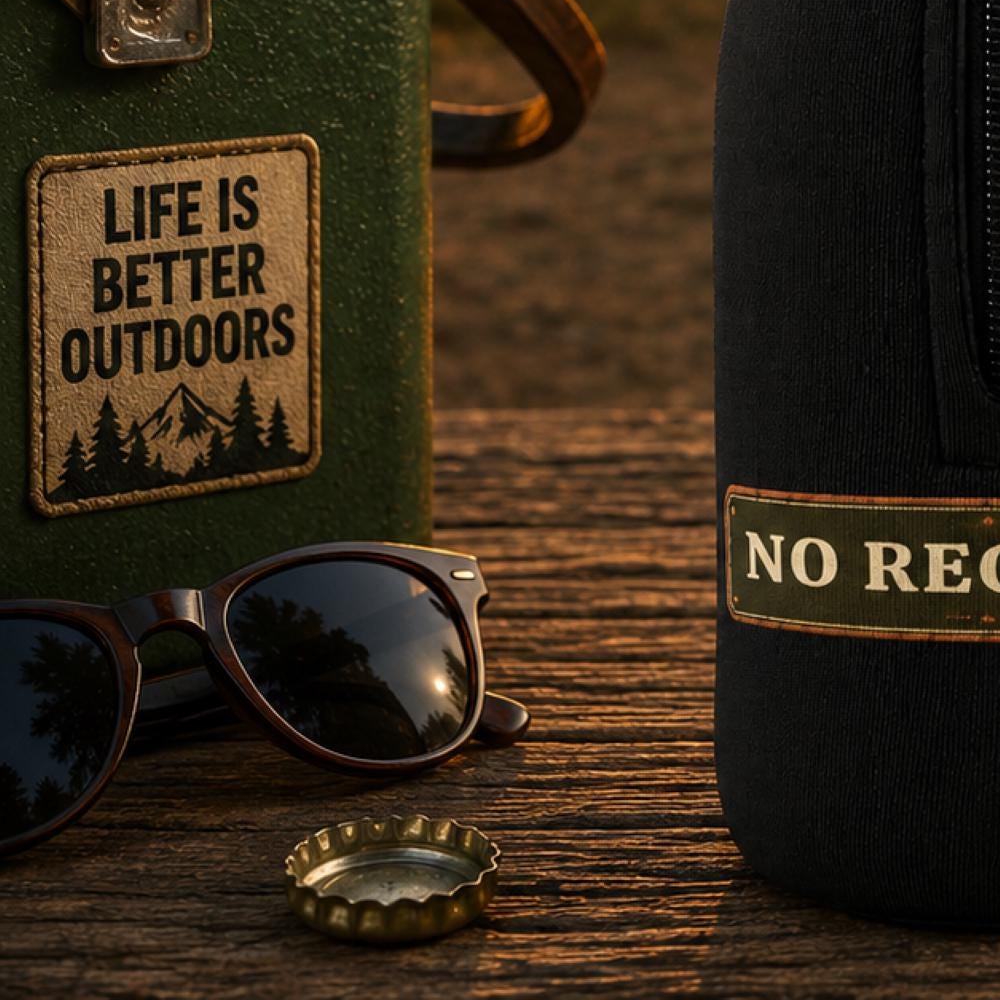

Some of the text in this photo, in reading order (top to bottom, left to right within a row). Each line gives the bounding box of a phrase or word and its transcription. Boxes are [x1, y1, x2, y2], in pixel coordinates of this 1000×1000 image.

[104, 175, 259, 245] LIFE IS
[93, 243, 265, 313] BETTER
[61, 304, 296, 384] OUTDOORS
[745, 530, 838, 588] NO
